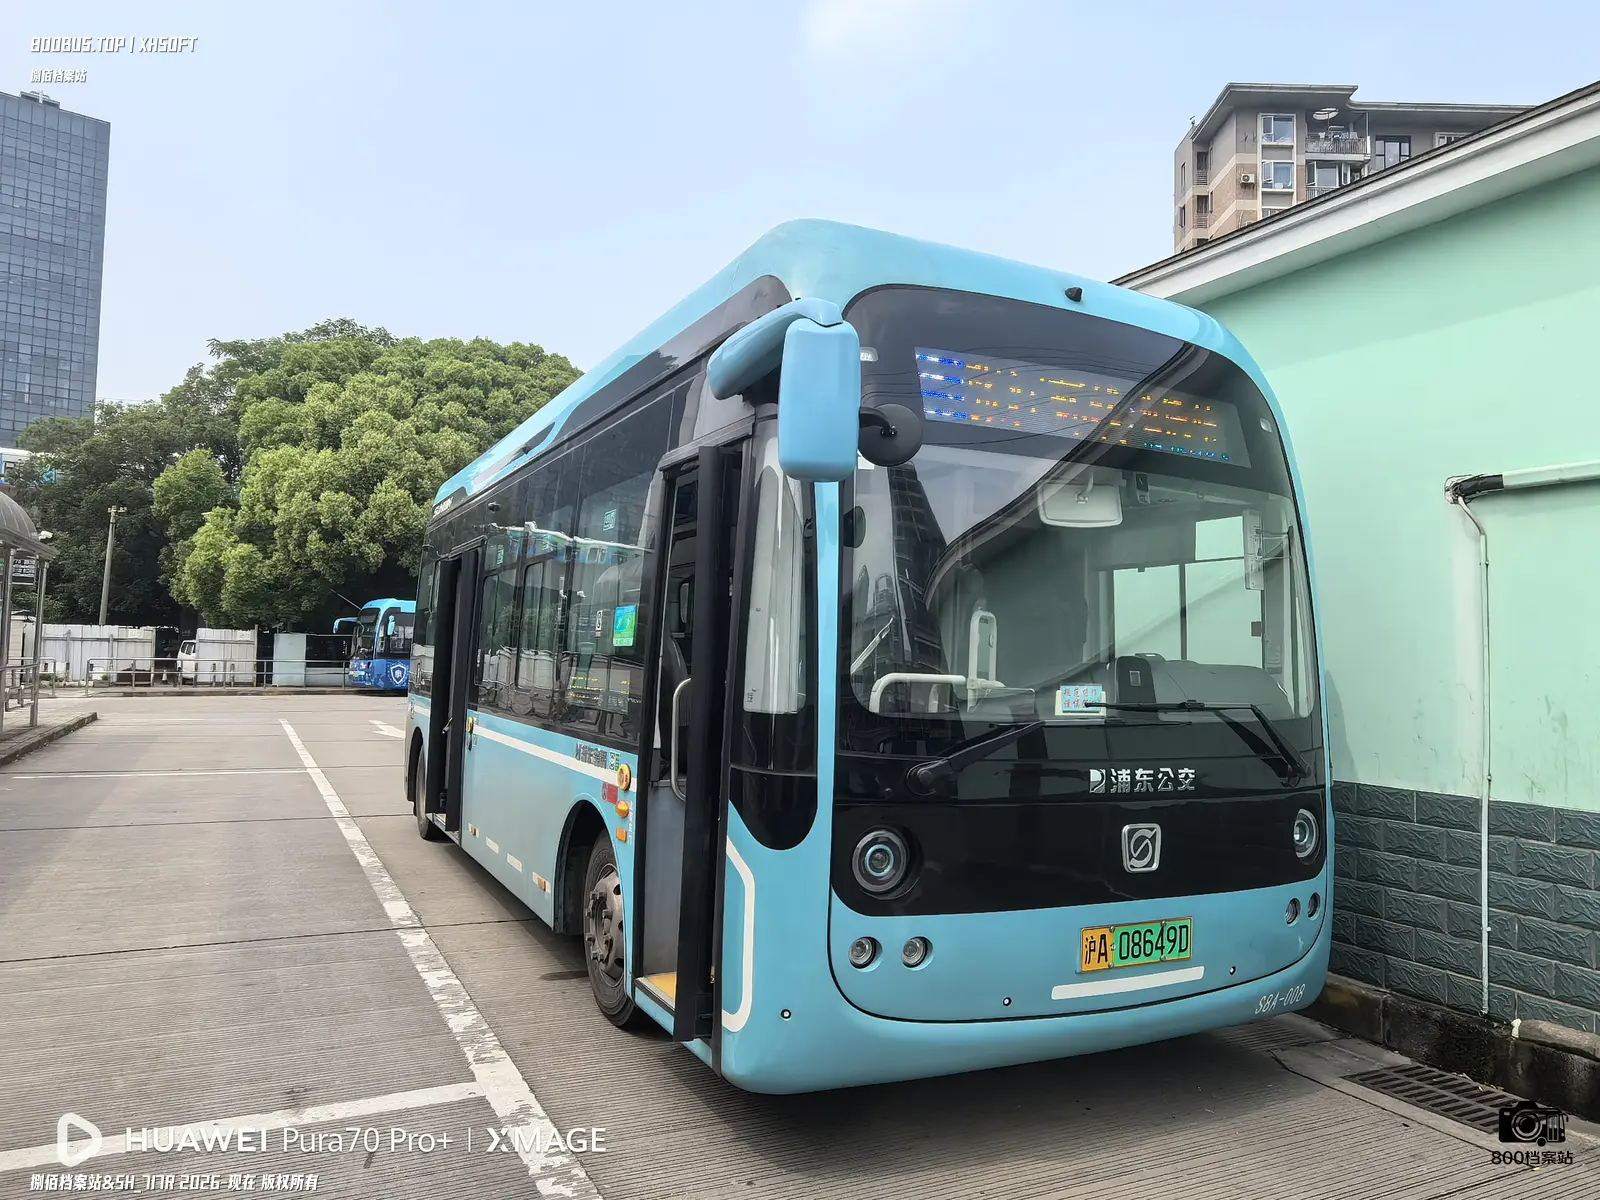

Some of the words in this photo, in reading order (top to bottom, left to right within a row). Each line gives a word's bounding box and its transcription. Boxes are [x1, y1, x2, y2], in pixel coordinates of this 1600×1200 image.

[1110, 768, 1196, 793] 浦东公交
[1253, 983, 1306, 1015] S8A-008
